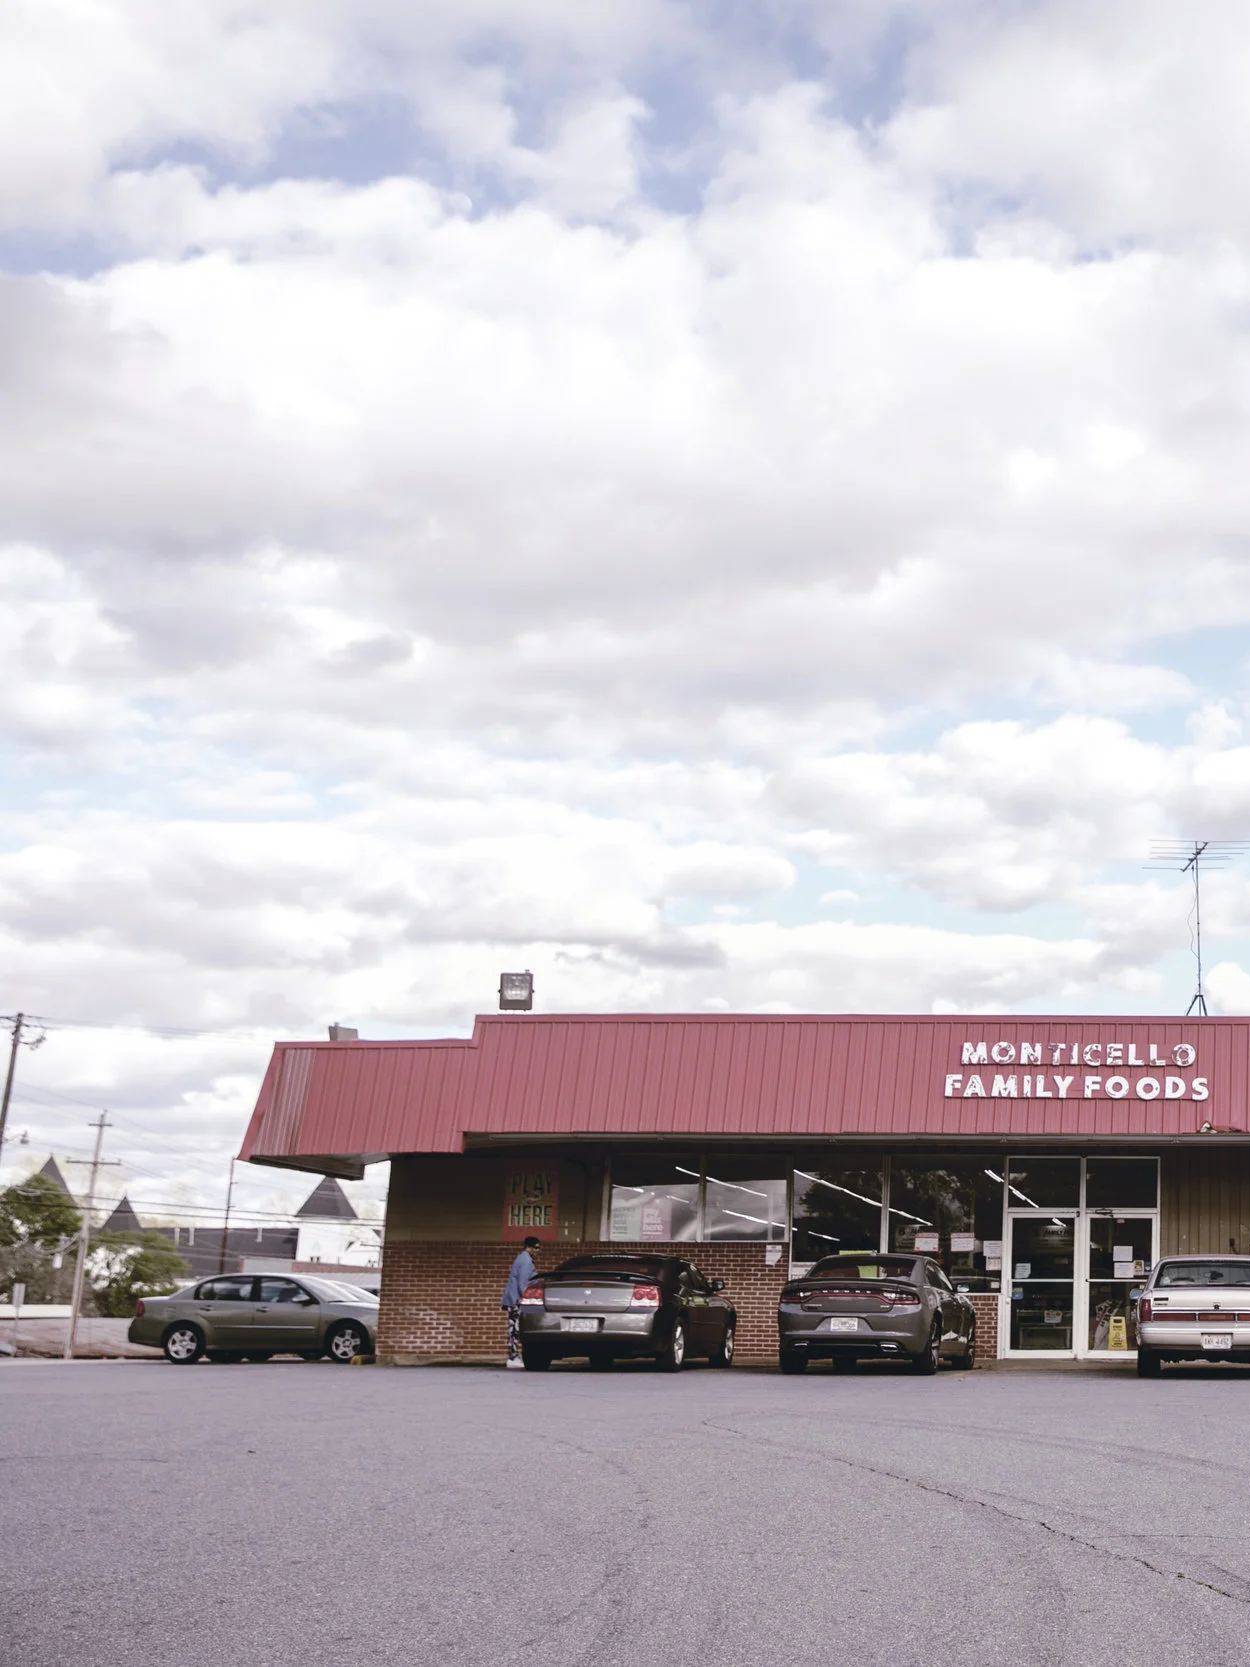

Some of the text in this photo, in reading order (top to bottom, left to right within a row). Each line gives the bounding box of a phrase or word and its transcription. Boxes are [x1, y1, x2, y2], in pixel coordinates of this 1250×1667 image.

[961, 1041, 1196, 1067] MONTICELLO
[945, 1074, 1209, 1101] FAMILY FOODS
[511, 1173, 552, 1195] PLAY
[508, 1204, 552, 1227] HERE
